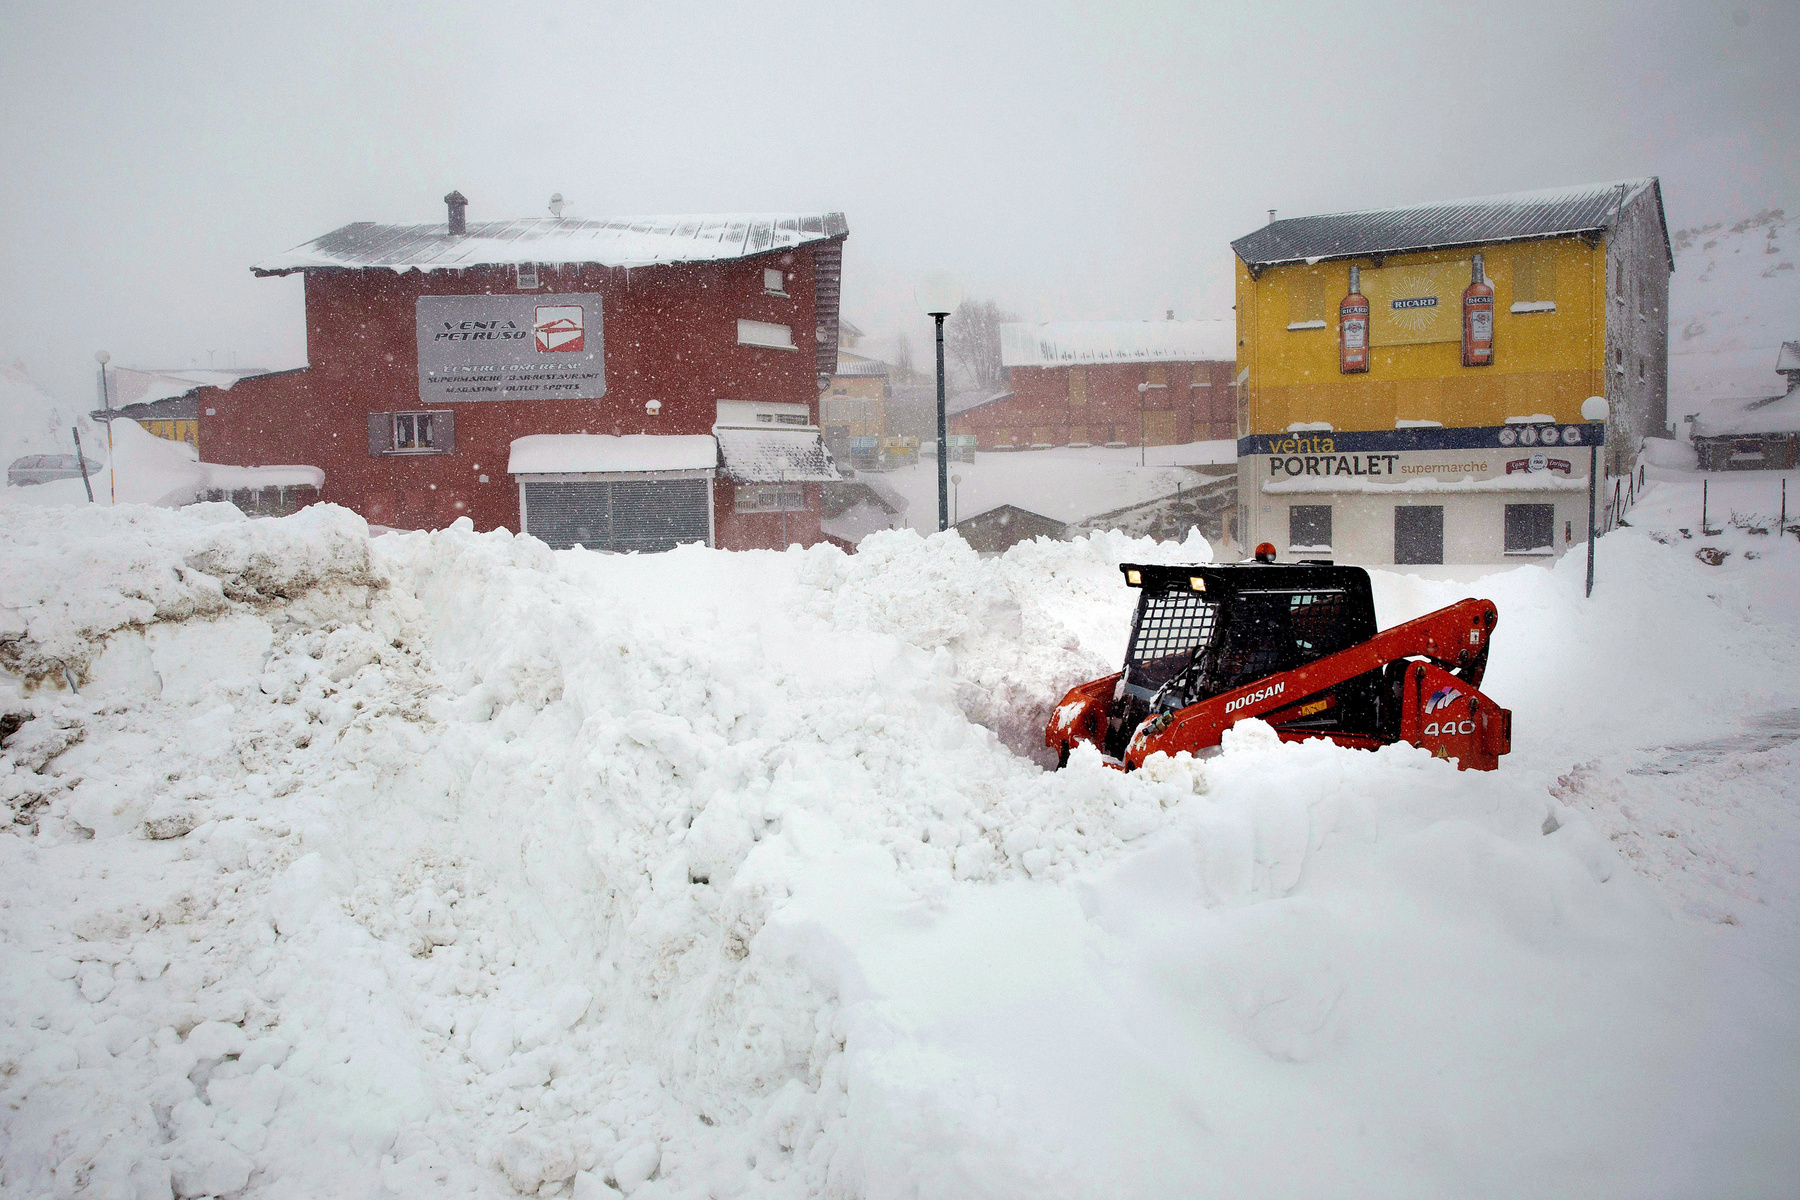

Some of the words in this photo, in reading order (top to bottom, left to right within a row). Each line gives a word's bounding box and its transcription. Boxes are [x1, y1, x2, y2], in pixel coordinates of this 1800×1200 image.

[1394, 299, 1436, 309] RICARD
[1342, 307, 1368, 315] RICARD
[444, 320, 517, 330] VENTA
[434, 331, 527, 342] PETRUSO
[542, 383, 580, 391] SPORTS
[1269, 435, 1335, 454] venta
[1269, 455, 1399, 477] PORTALET
[1401, 461, 1488, 475] supermarché
[1225, 681, 1285, 714] DOOSAN
[1424, 720, 1476, 737] 440
